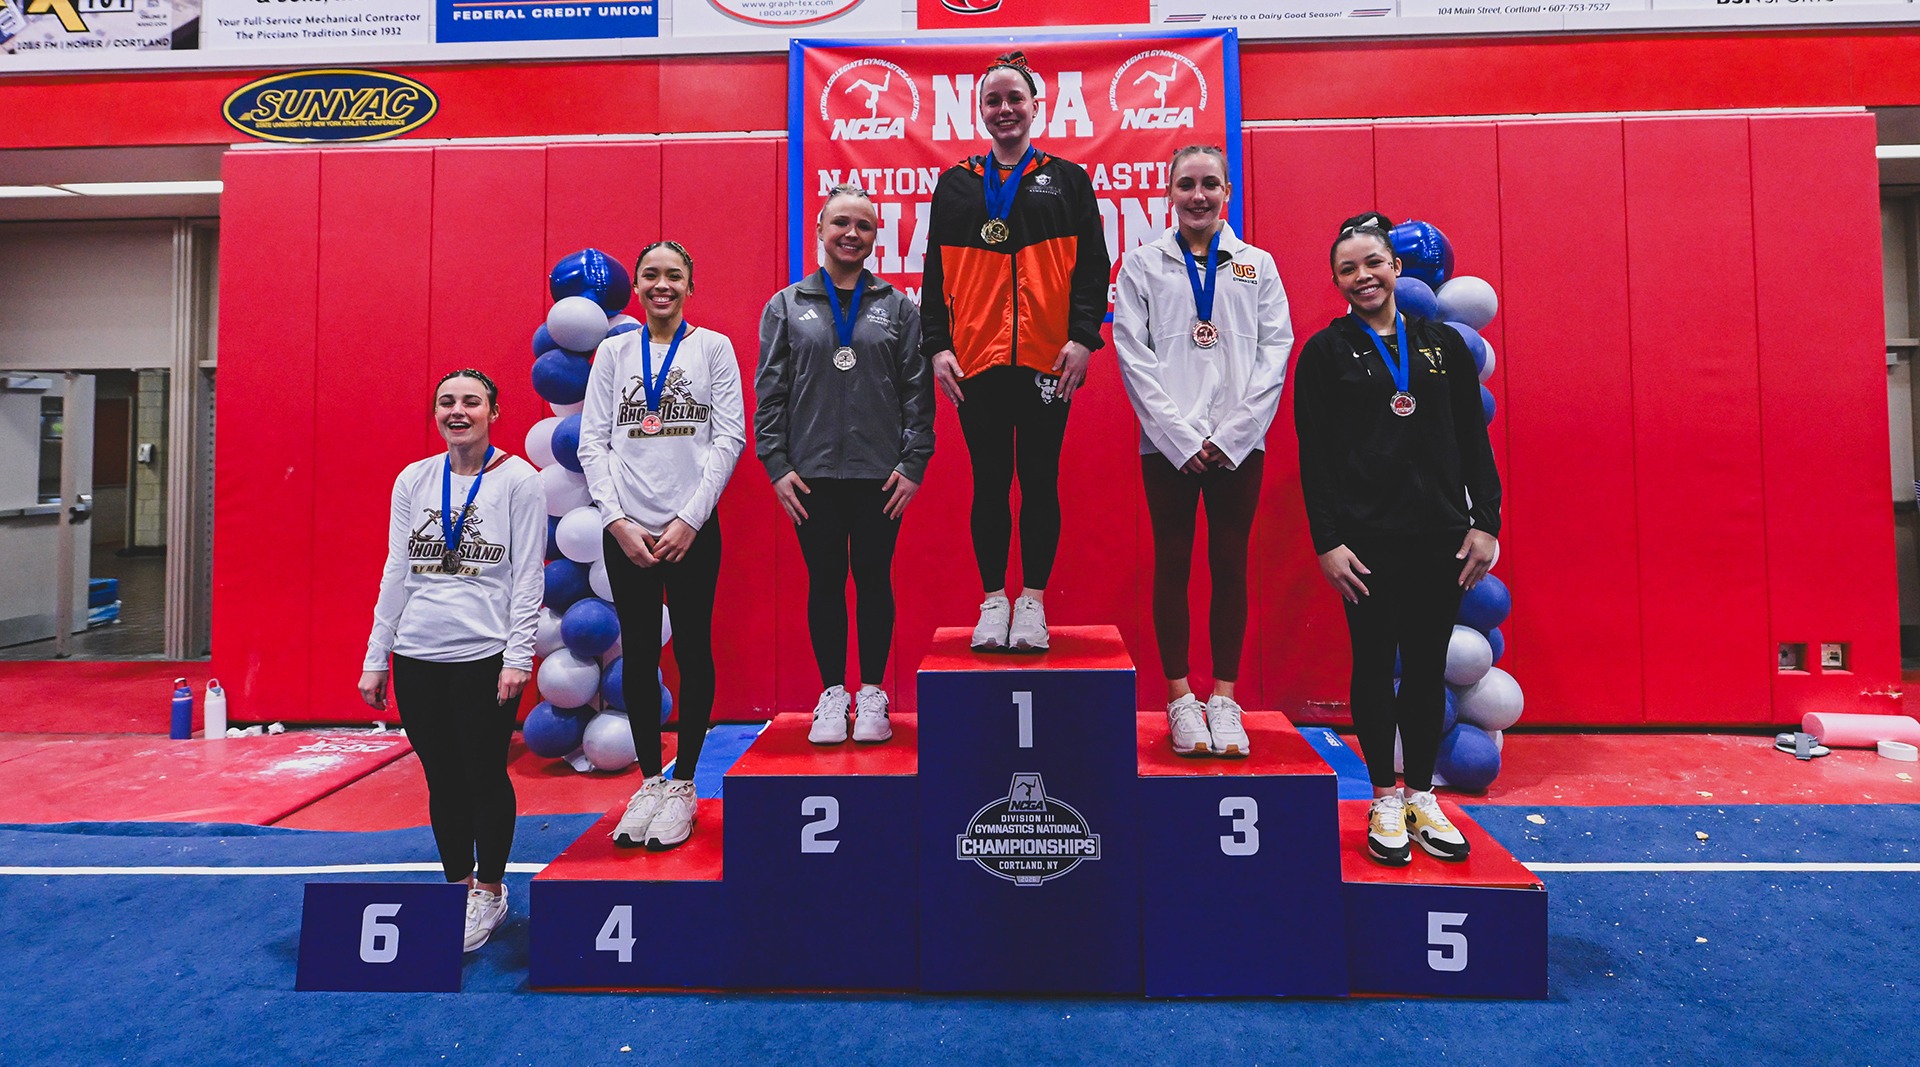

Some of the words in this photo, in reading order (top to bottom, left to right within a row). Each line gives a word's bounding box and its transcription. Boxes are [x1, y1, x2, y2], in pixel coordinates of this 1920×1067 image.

[742, 0, 833, 8] www.graph-tex.com
[1438, 7, 1452, 15] 104
[1454, 6, 1475, 15] Main
[1505, 5, 1541, 14] Cortland
[1549, 3, 1611, 13] 607-753-7527
[217, 18, 240, 27] Your
[244, 16, 302, 26] Full-Service
[305, 14, 362, 24] Mechanical
[365, 14, 421, 23] Contractor
[453, 10, 526, 21] FEDERAL
[531, 8, 592, 19] CREDIT
[598, 6, 653, 16] UNION
[1259, 12, 1282, 21] Dairy
[1309, 11, 1342, 19] Season!
[236, 31, 253, 40] The
[257, 30, 299, 39] Picciano
[302, 28, 348, 38] Tradition
[351, 28, 377, 37] Since
[381, 27, 402, 36] 1932
[114, 38, 170, 48] CORTLAND
[250, 86, 419, 122] SUNYAC
[932, 71, 1094, 141] NA
[1120, 107, 1195, 130] NCGA
[830, 117, 905, 141] NCGA
[817, 167, 940, 197] NATION
[1231, 262, 1256, 279] UC
[619, 404, 657, 424] RHO
[665, 401, 707, 421] ISLAND
[459, 544, 502, 562] SLAND
[1012, 691, 1033, 748] 1
[1010, 800, 1044, 811] NCGA
[801, 796, 840, 853] 2
[1001, 814, 1041, 823] DIVISION
[1045, 814, 1055, 823] III
[1219, 796, 1260, 856] 3
[975, 824, 1035, 834] GYMNASTICS
[1036, 824, 1082, 834] NATIONAL
[961, 838, 1096, 856] CHAMPIONSHIPS
[999, 861, 1045, 871] CORTLAND,
[1047, 861, 1058, 870] NY
[359, 903, 402, 963] 6
[595, 904, 637, 963] 4
[1428, 911, 1469, 972] 5
